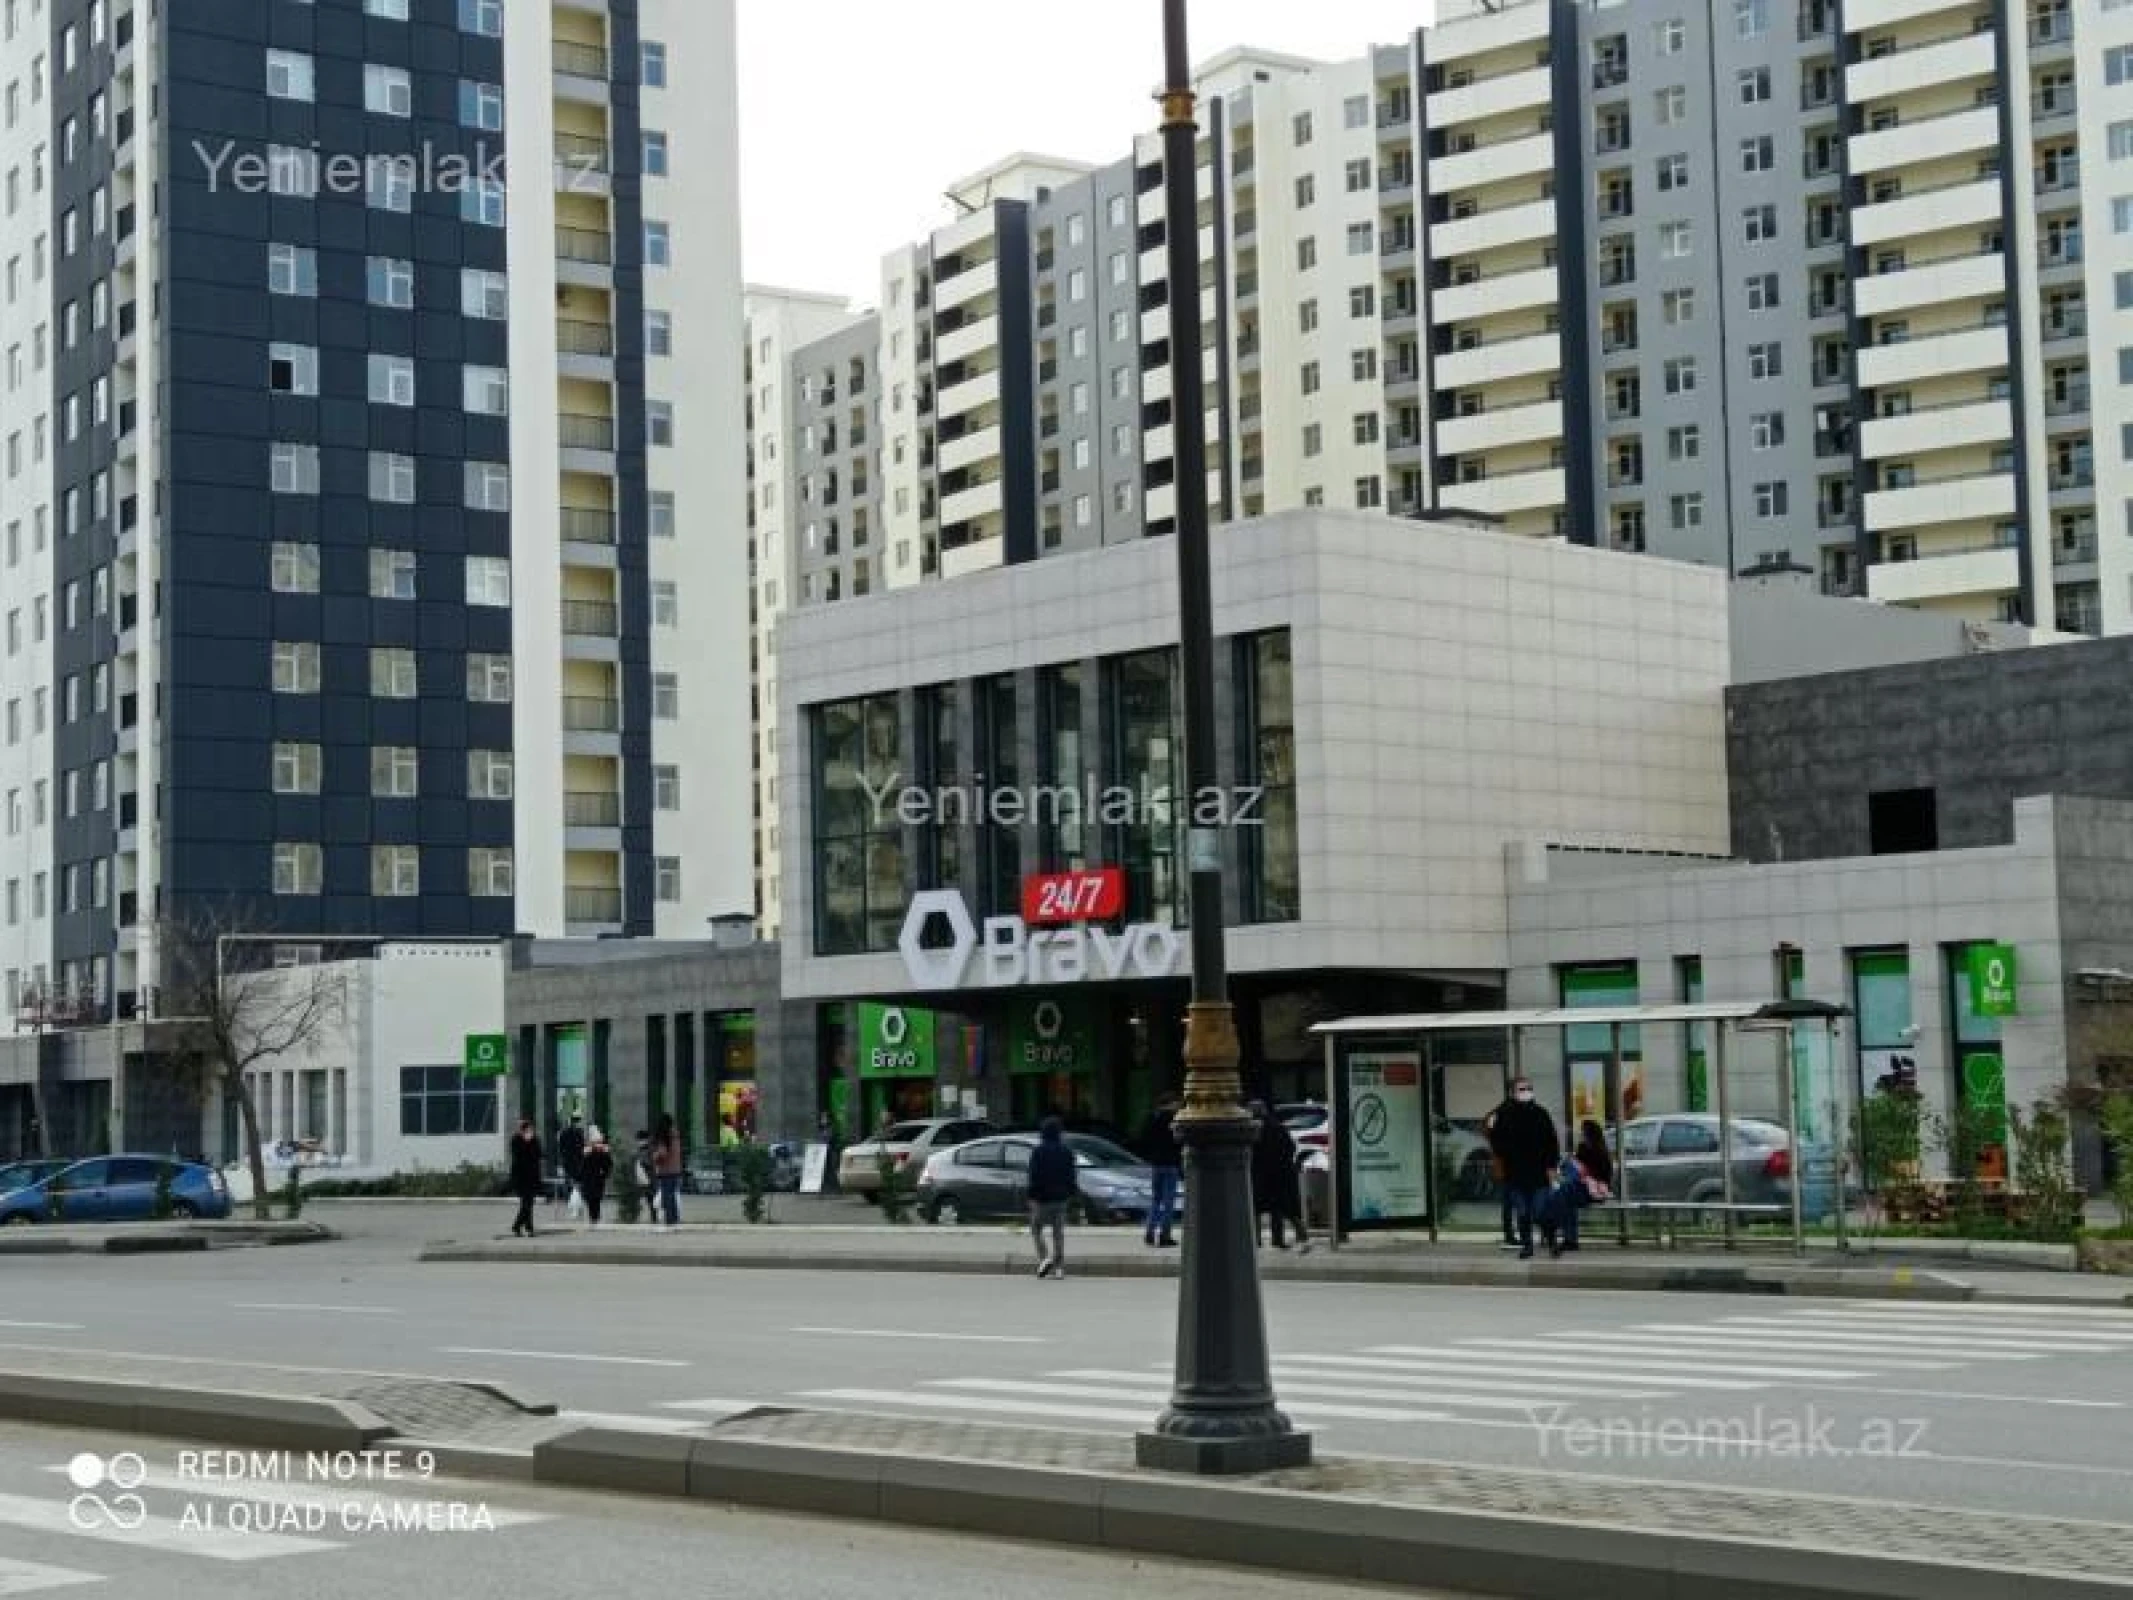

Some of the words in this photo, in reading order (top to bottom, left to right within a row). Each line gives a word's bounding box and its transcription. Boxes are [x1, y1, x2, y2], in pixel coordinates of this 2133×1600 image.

[1039, 876, 1104, 916] 24/7
[983, 915, 1178, 985] Bravo
[872, 1047, 917, 1068] Bravo
